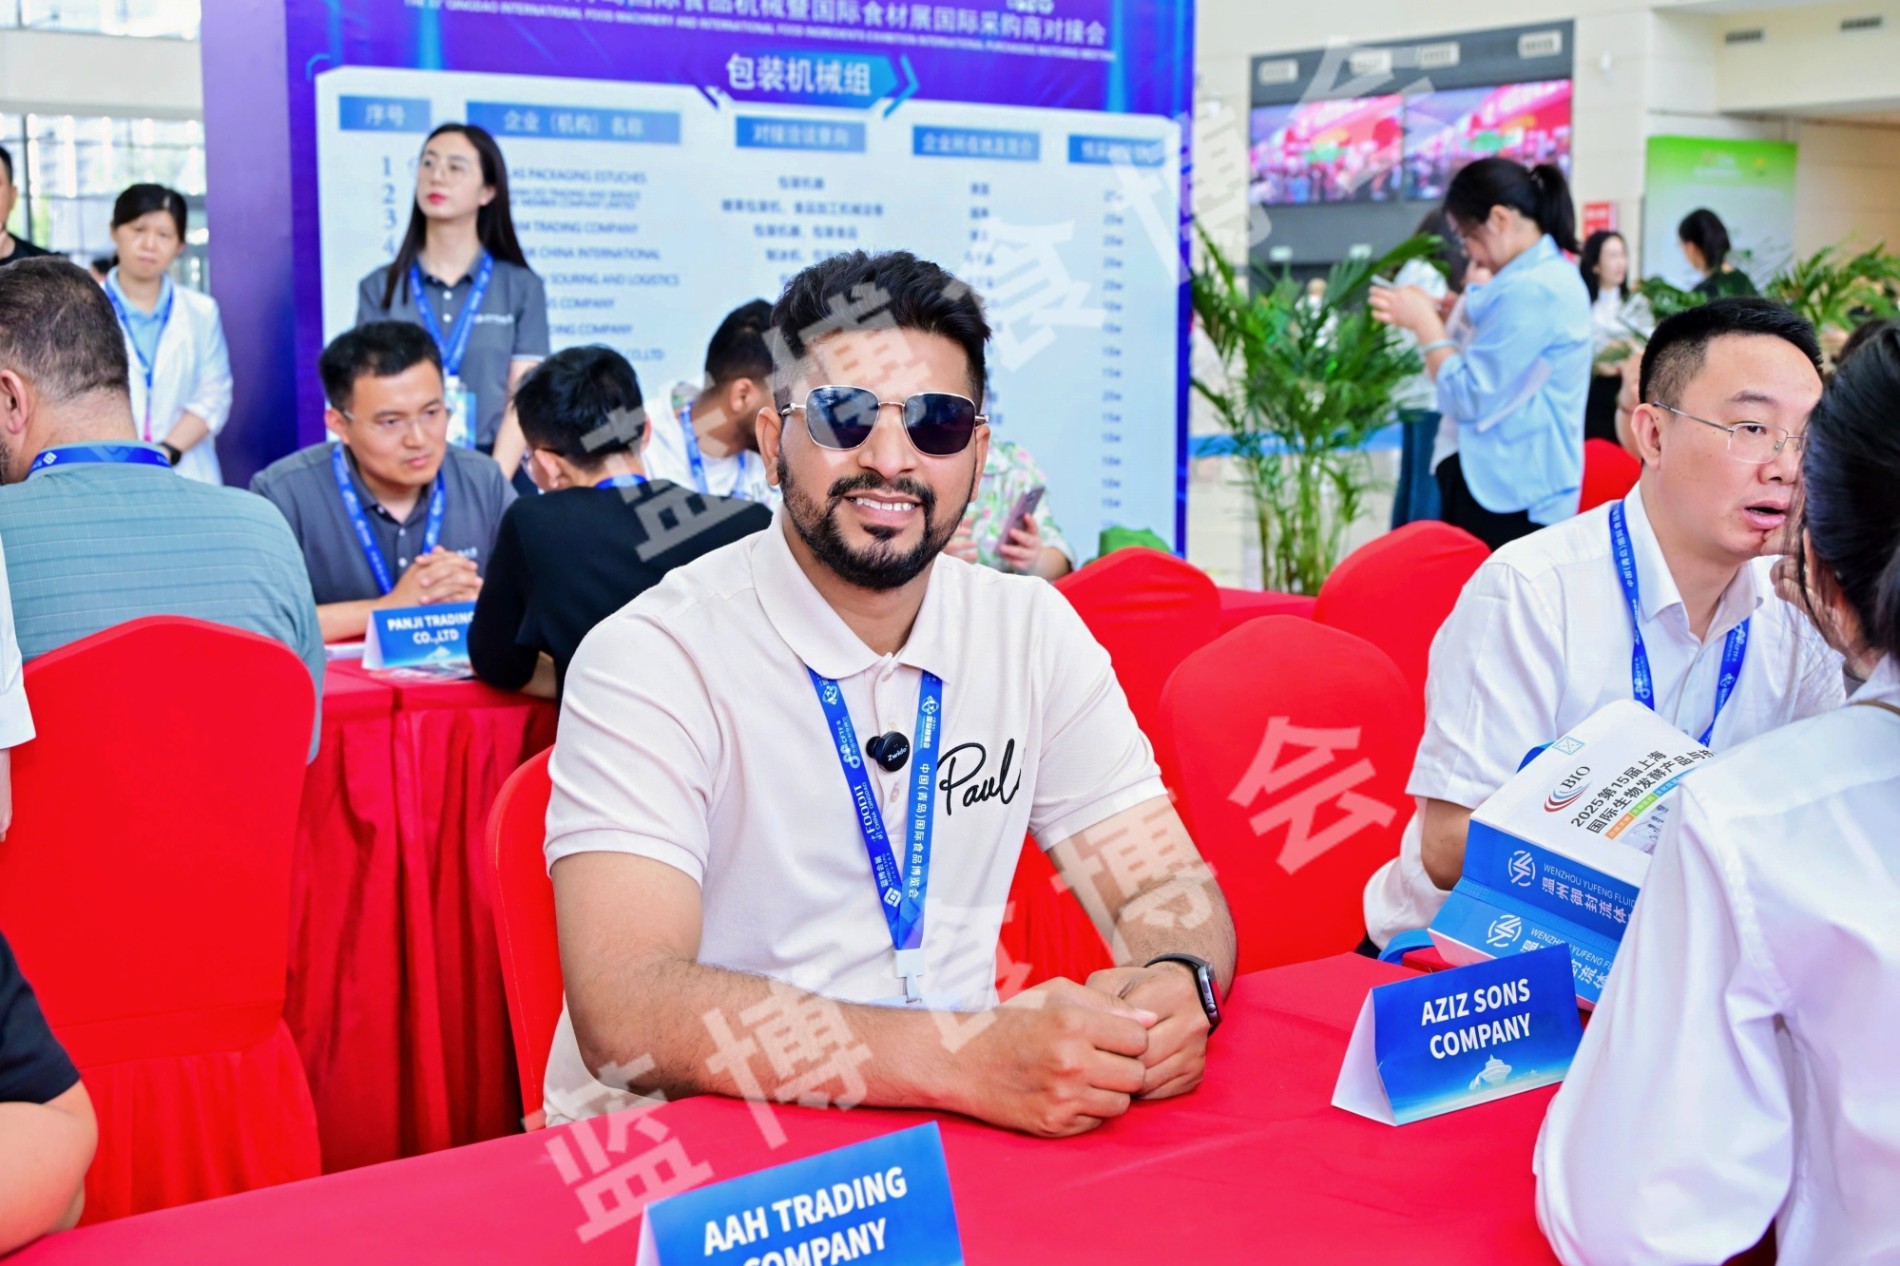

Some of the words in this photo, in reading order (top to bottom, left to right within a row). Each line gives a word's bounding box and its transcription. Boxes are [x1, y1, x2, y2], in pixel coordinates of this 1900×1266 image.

[725, 53, 872, 96] 包装机械组
[365, 106, 406, 126] 序号
[387, 614, 424, 631] PANJI
[936, 738, 1021, 816] Paul
[1559, 765, 1591, 790] BIO
[853, 785, 875, 834] FOODIT
[1542, 877, 1631, 924] 温州御封流体
[1543, 863, 1581, 886] WENZHOU
[1583, 879, 1613, 899] YUFENG
[1572, 945, 1604, 966] YUFENG
[1421, 992, 1470, 1026] AZIZ
[1474, 978, 1531, 1013] SONS
[1429, 1013, 1531, 1060] COMPANY
[704, 1206, 769, 1257] AAH
[771, 1166, 908, 1233] TRADING
